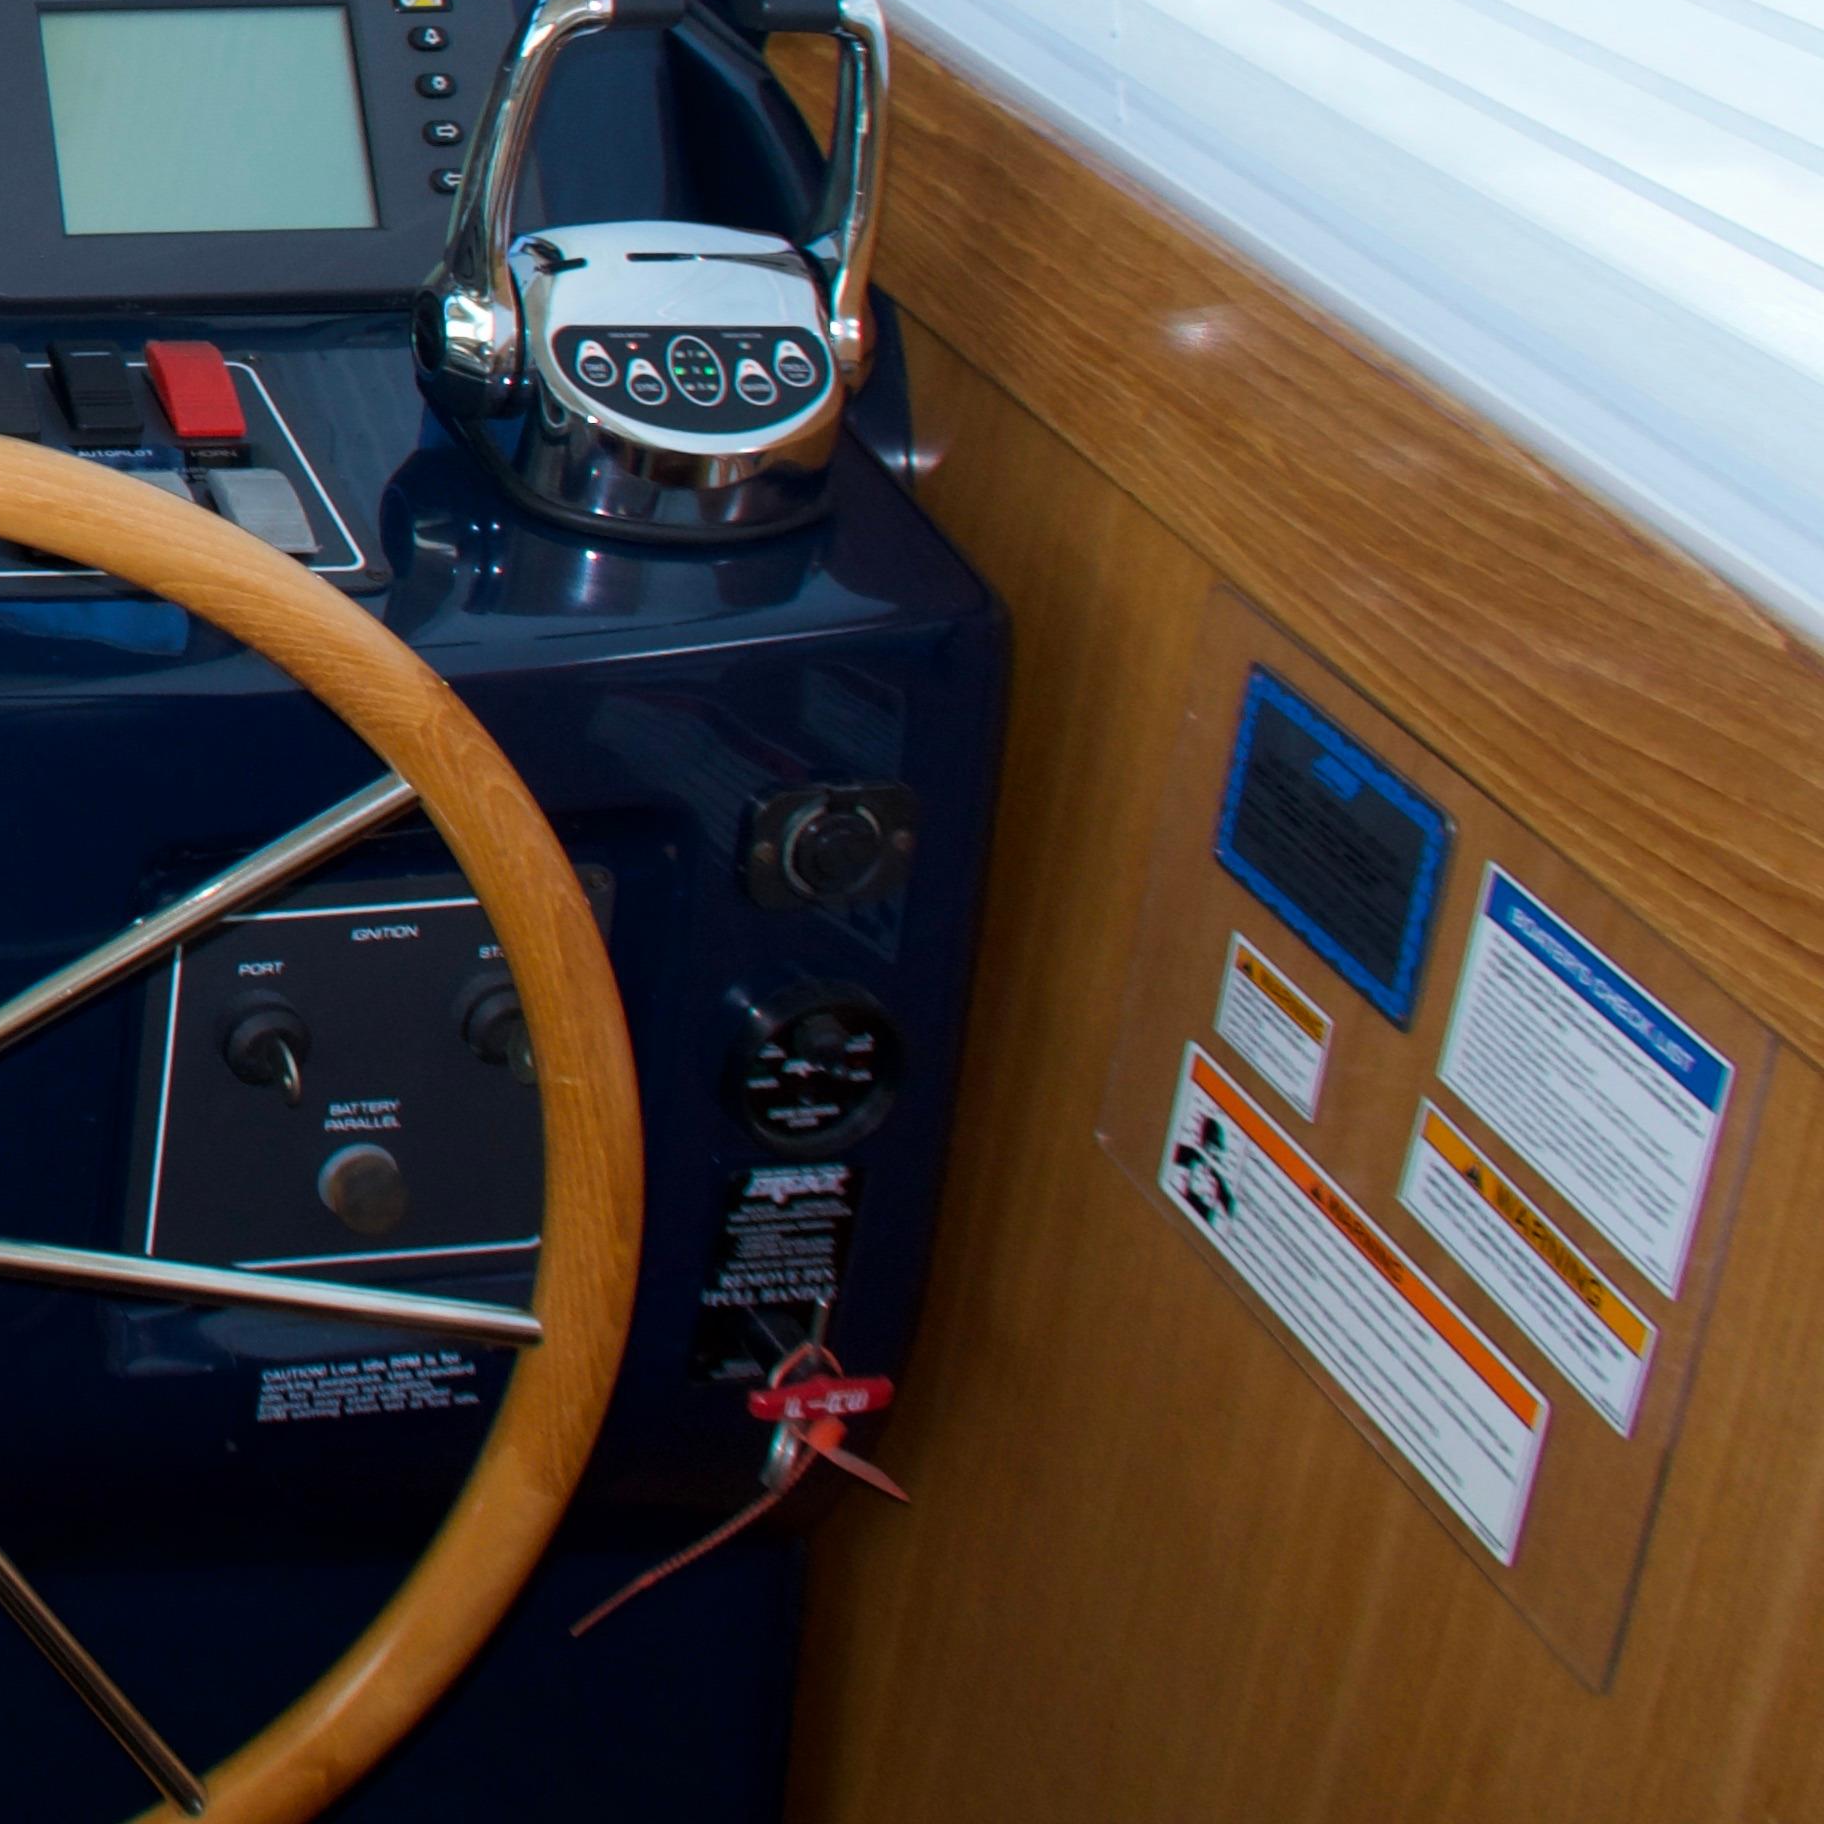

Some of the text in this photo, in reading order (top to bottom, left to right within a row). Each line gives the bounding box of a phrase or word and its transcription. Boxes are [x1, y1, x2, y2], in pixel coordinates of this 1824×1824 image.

[350, 924, 420, 941] IGNITION
[237, 960, 286, 977] PORT
[1591, 975, 1655, 1036] CHECK
[1651, 1029, 1697, 1073] LIST
[328, 1098, 402, 1117] BATTERY
[323, 1113, 403, 1132] PARALLEL
[1492, 1181, 1605, 1311] WARNING
